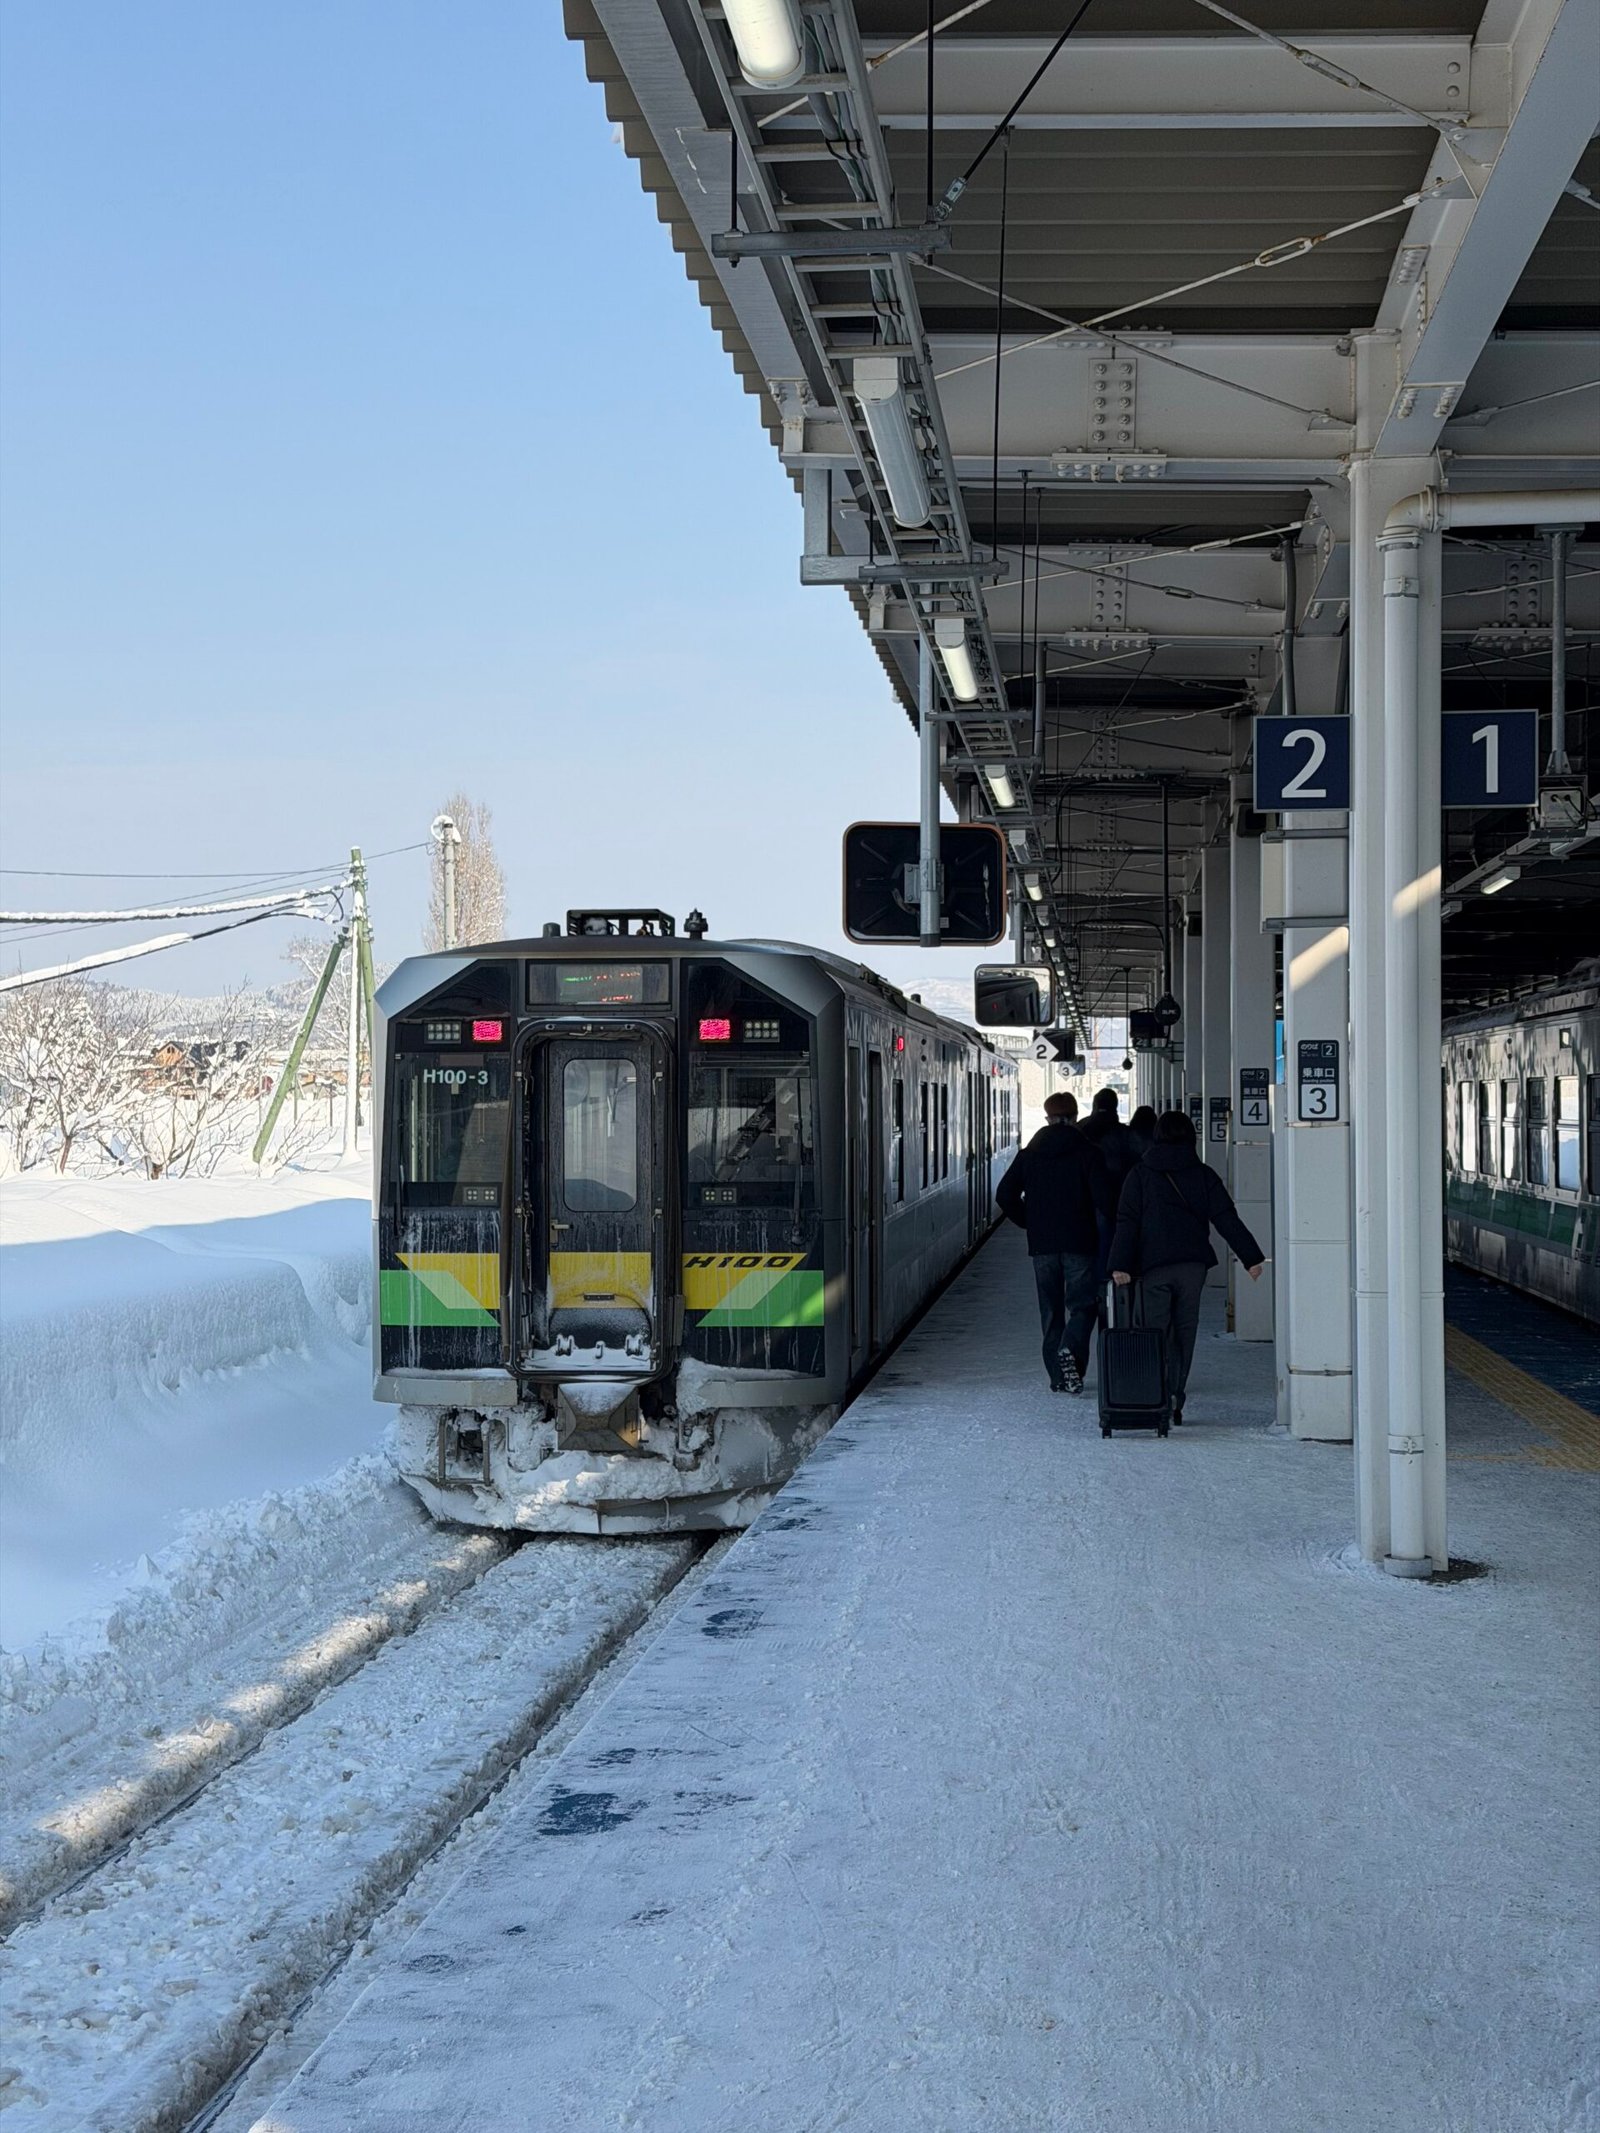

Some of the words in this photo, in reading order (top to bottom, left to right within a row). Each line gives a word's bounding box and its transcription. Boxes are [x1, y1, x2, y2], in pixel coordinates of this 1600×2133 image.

[1281, 729, 1327, 798] 2
[1472, 724, 1499, 793] 1
[1036, 1044, 1047, 1059] 2
[1325, 1045, 1333, 1056] 2
[423, 1069, 489, 1085] H100-3
[1062, 1067, 1070, 1076] 3
[1302, 1067, 1335, 1078] 乗車口
[1309, 1087, 1327, 1115] 3
[1248, 1102, 1263, 1121] 4
[1195, 1119, 1203, 1131] 6
[1216, 1123, 1227, 1138] 5
[684, 1256, 794, 1268] H100
